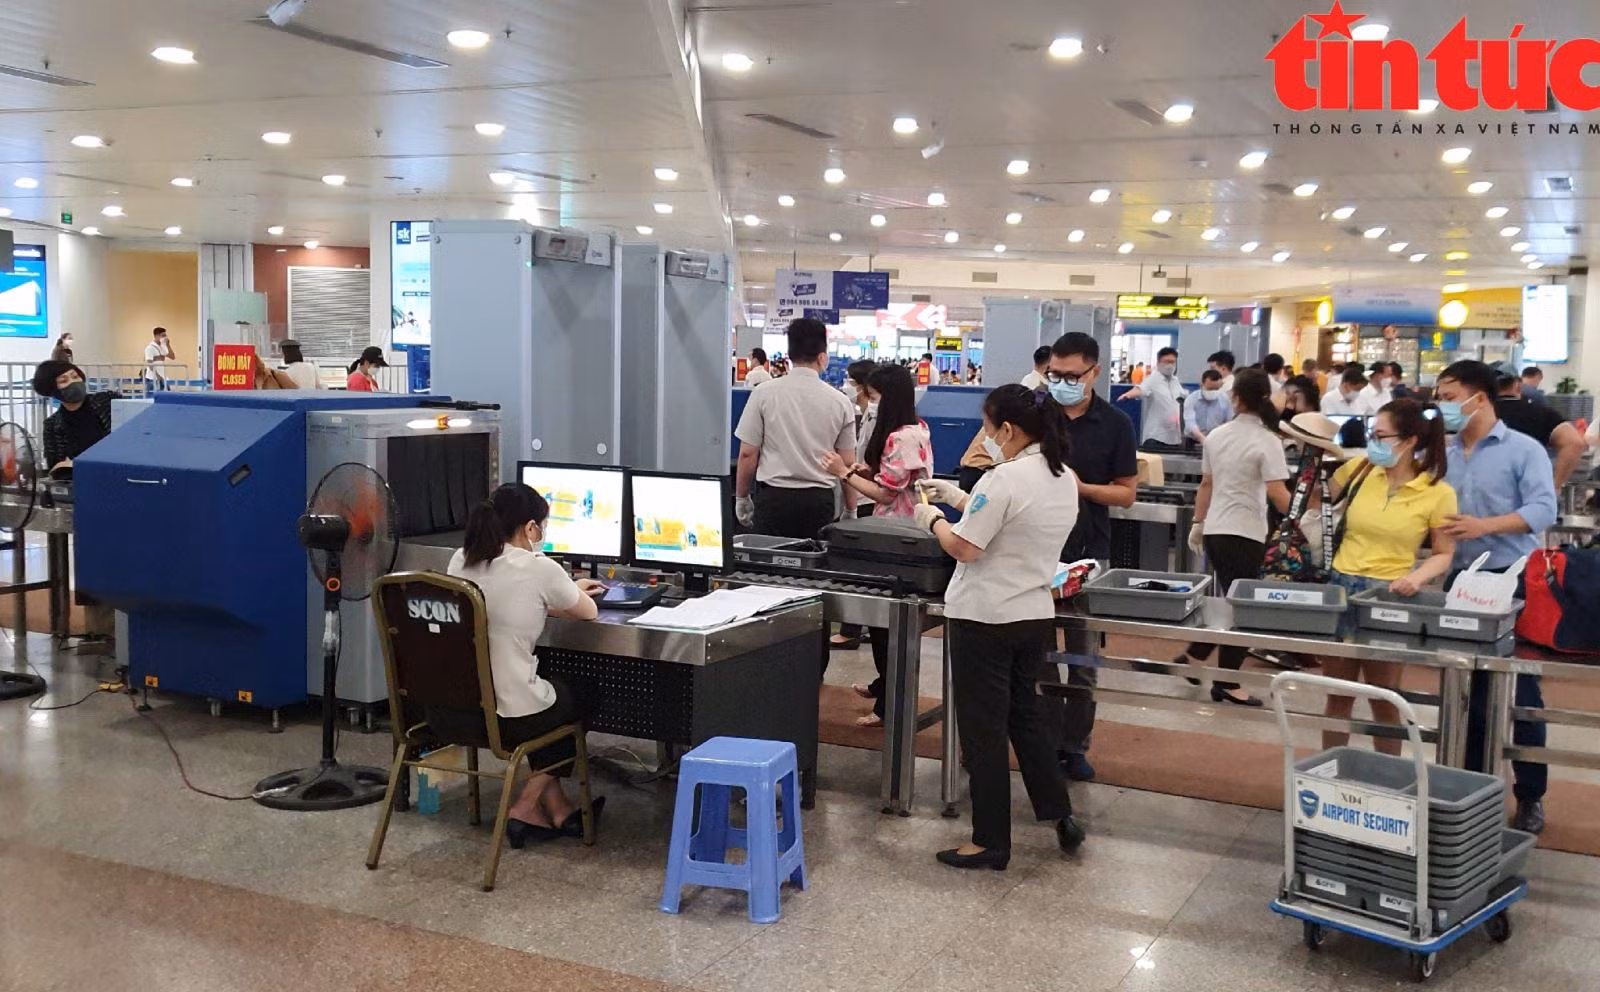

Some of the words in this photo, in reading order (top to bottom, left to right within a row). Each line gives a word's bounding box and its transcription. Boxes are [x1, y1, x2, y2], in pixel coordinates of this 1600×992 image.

[222, 374, 246, 384] CLOSED
[1268, 592, 1288, 600] ACV
[1322, 802, 1360, 825] AIRPORT
[1363, 812, 1409, 837] SECURITY
